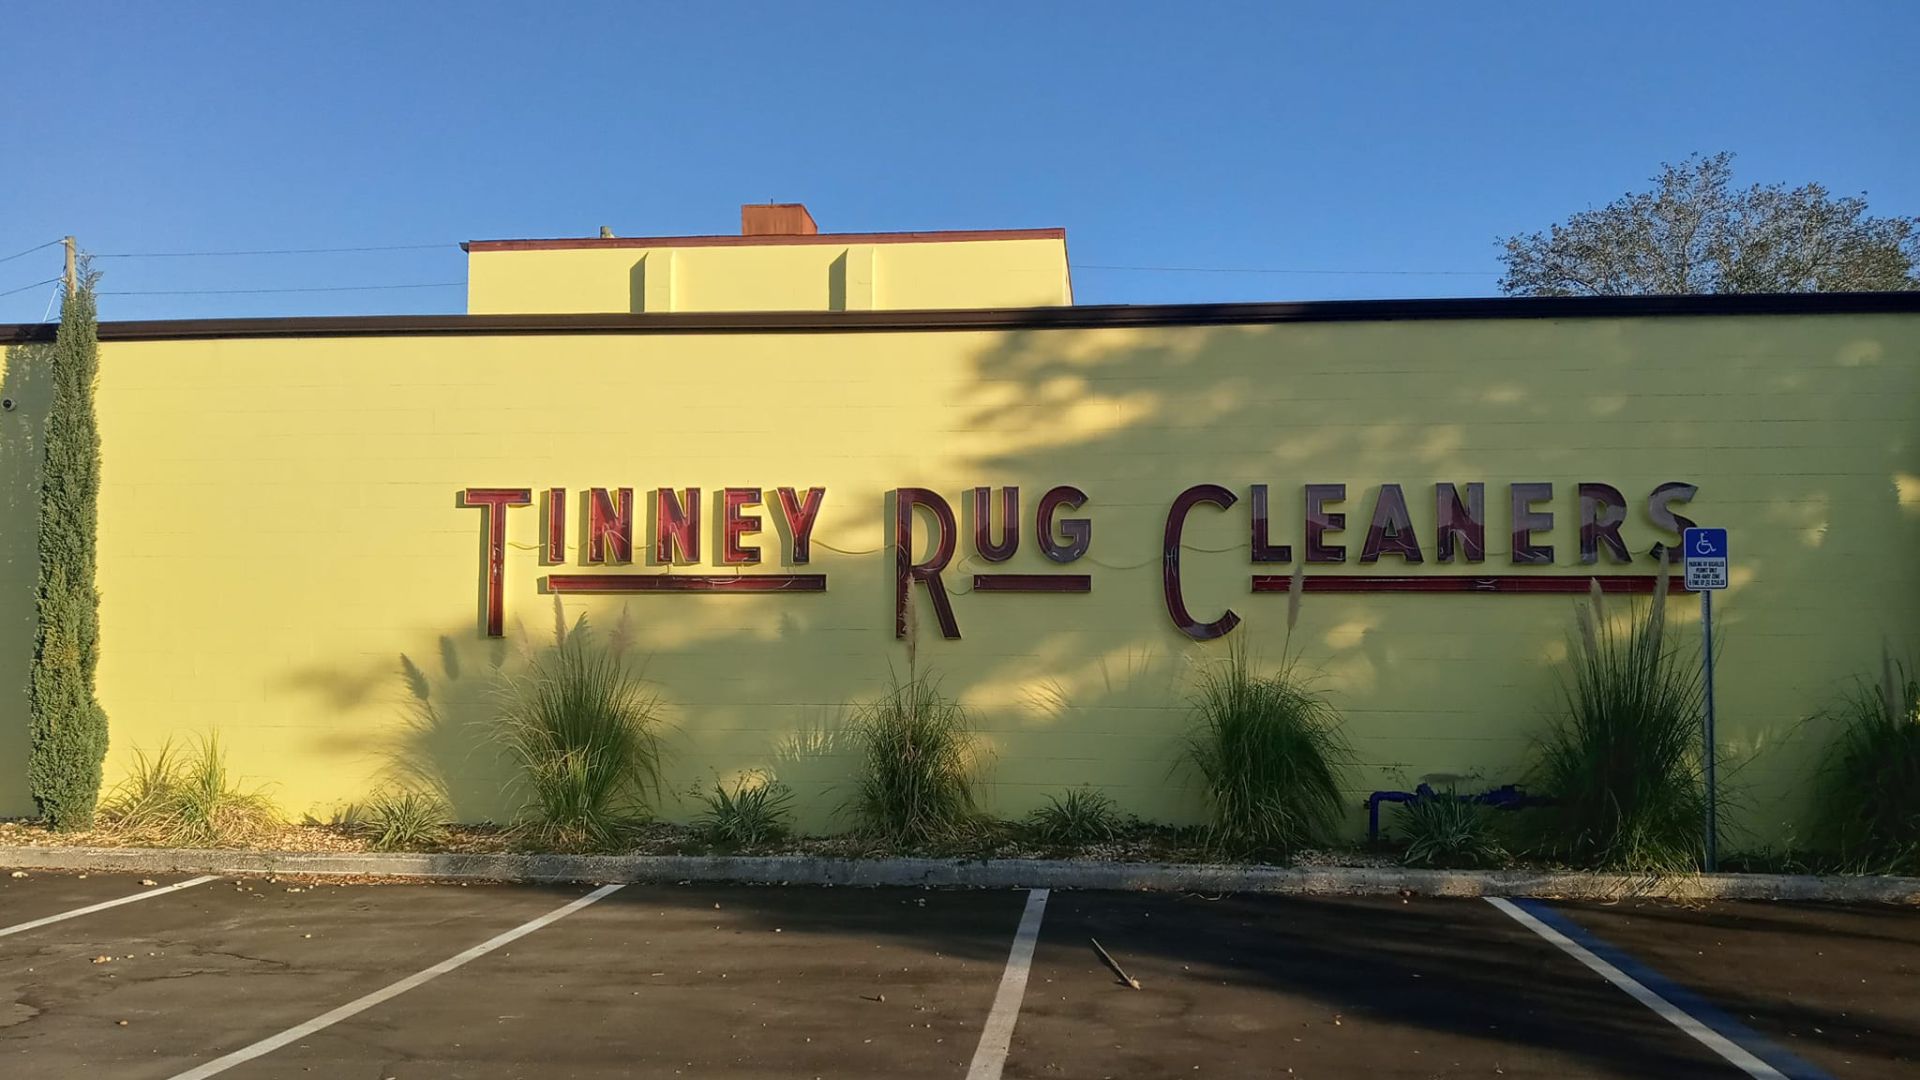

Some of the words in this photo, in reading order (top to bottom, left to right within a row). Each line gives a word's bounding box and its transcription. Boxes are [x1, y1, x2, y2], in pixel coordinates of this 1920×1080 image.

[465, 487, 826, 637] TINNEY
[895, 485, 1091, 639] RUG
[1163, 481, 1698, 641] CLEANERS
